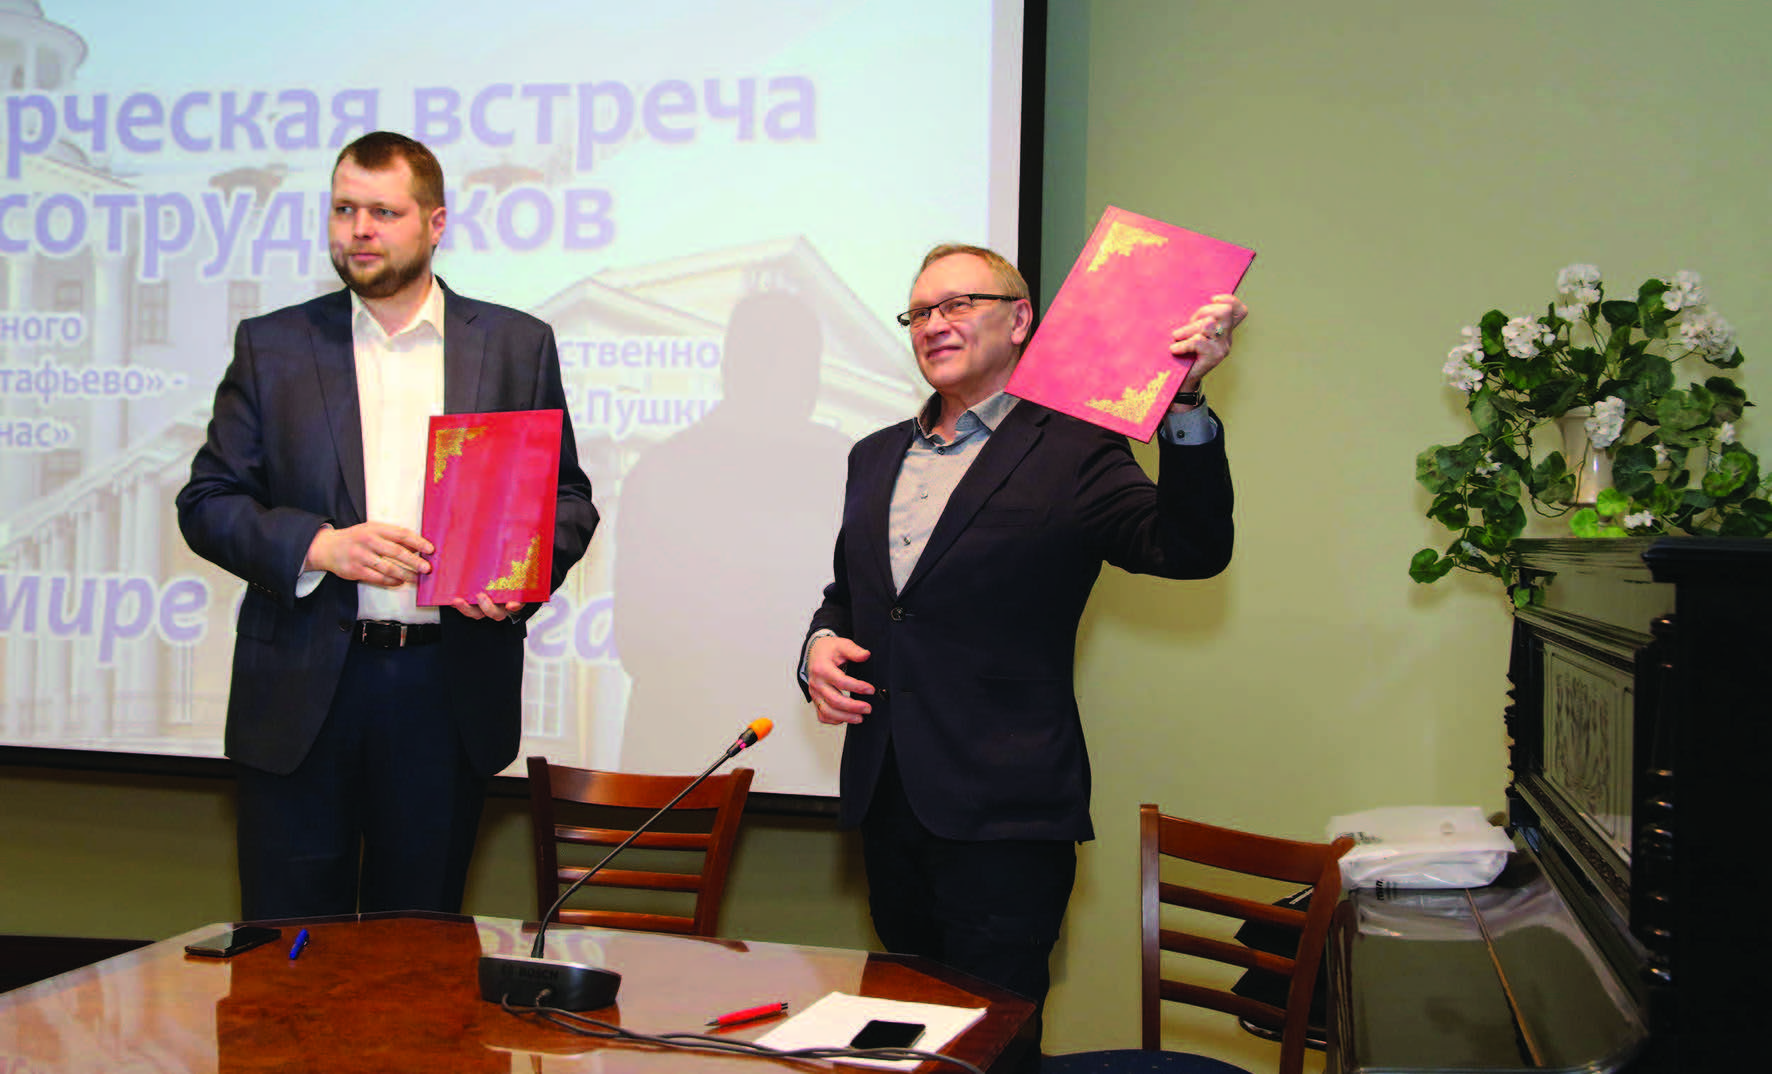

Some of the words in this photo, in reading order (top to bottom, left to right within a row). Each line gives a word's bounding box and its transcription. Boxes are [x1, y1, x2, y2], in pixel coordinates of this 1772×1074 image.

[6, 87, 380, 179] рческая
[413, 75, 817, 172] встреча
[0, 316, 81, 341] ного
[0, 360, 164, 404] тафьево»
